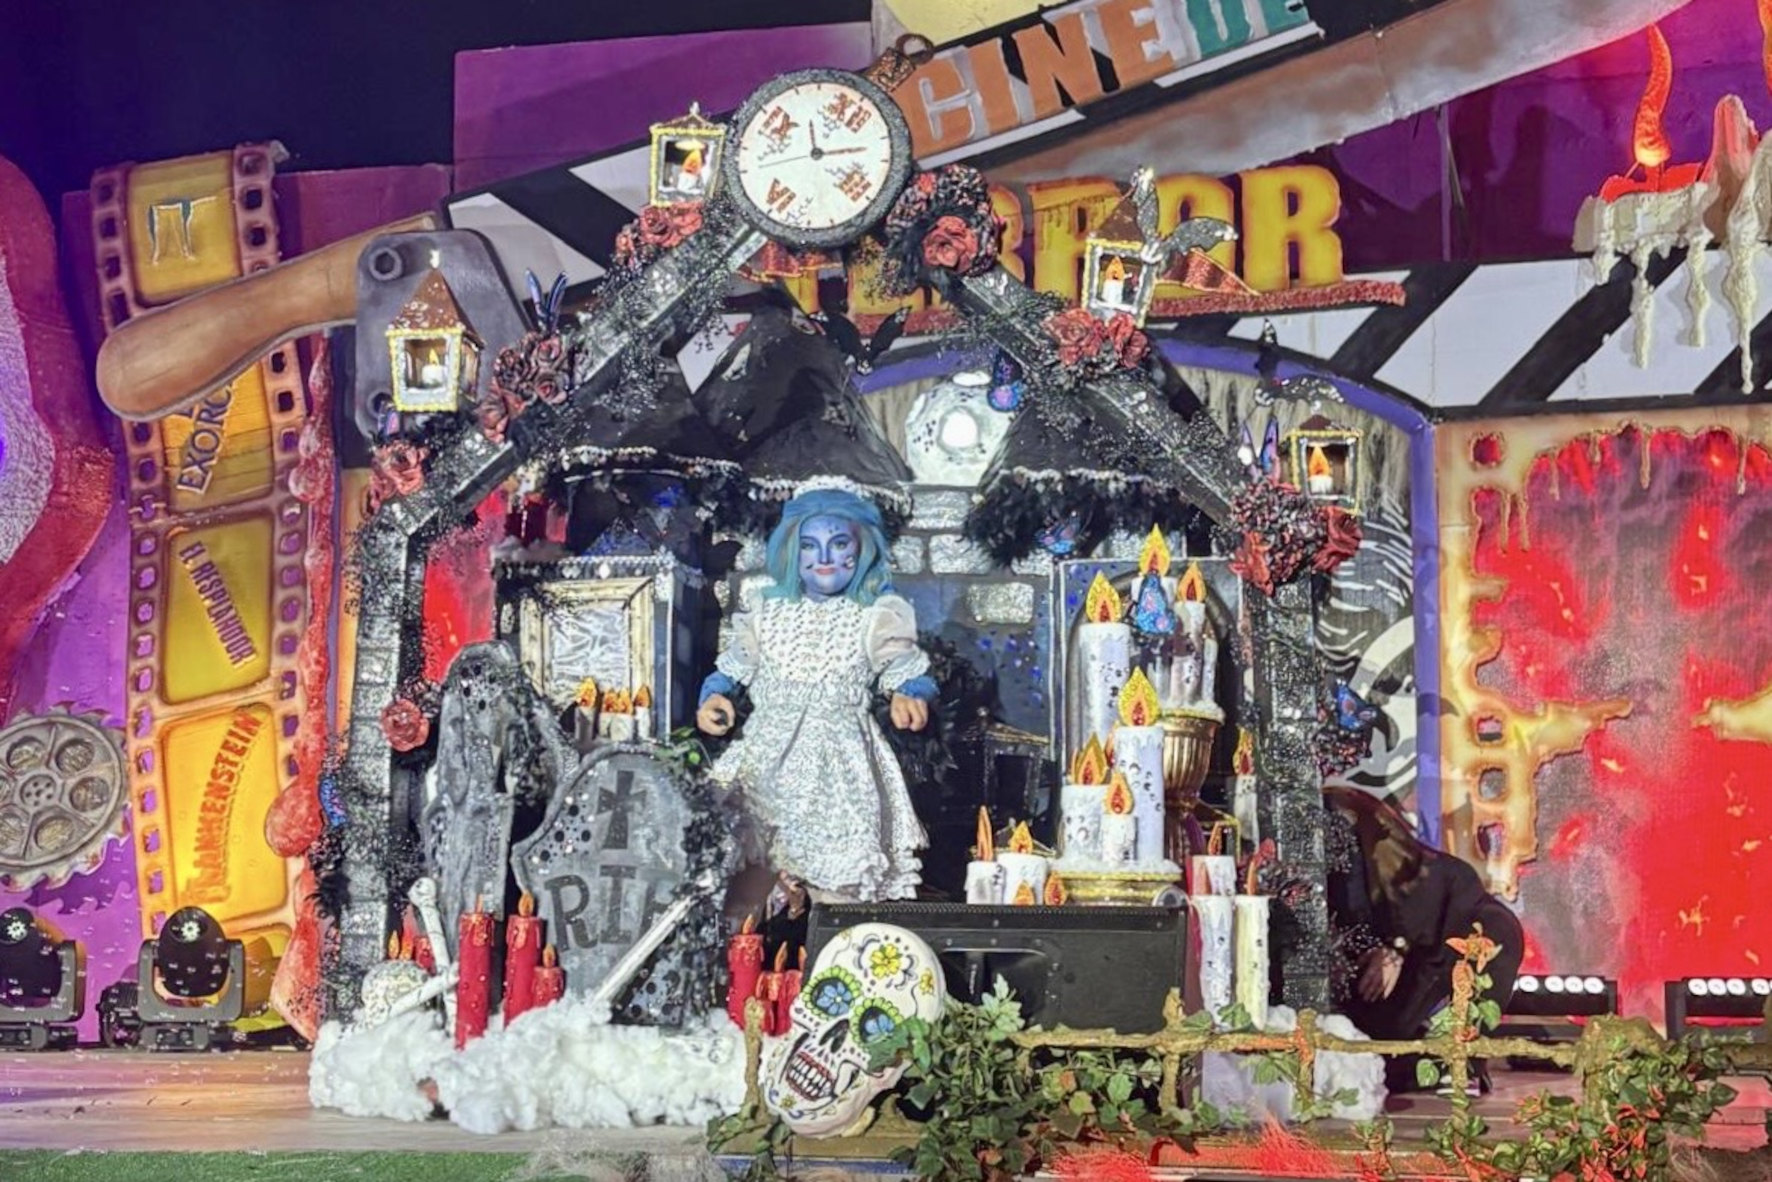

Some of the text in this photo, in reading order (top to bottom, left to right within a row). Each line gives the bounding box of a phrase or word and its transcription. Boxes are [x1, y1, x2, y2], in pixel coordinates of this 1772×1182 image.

[892, 0, 1178, 158] CINE
[178, 384, 232, 491] EXORC
[179, 541, 206, 565] EL
